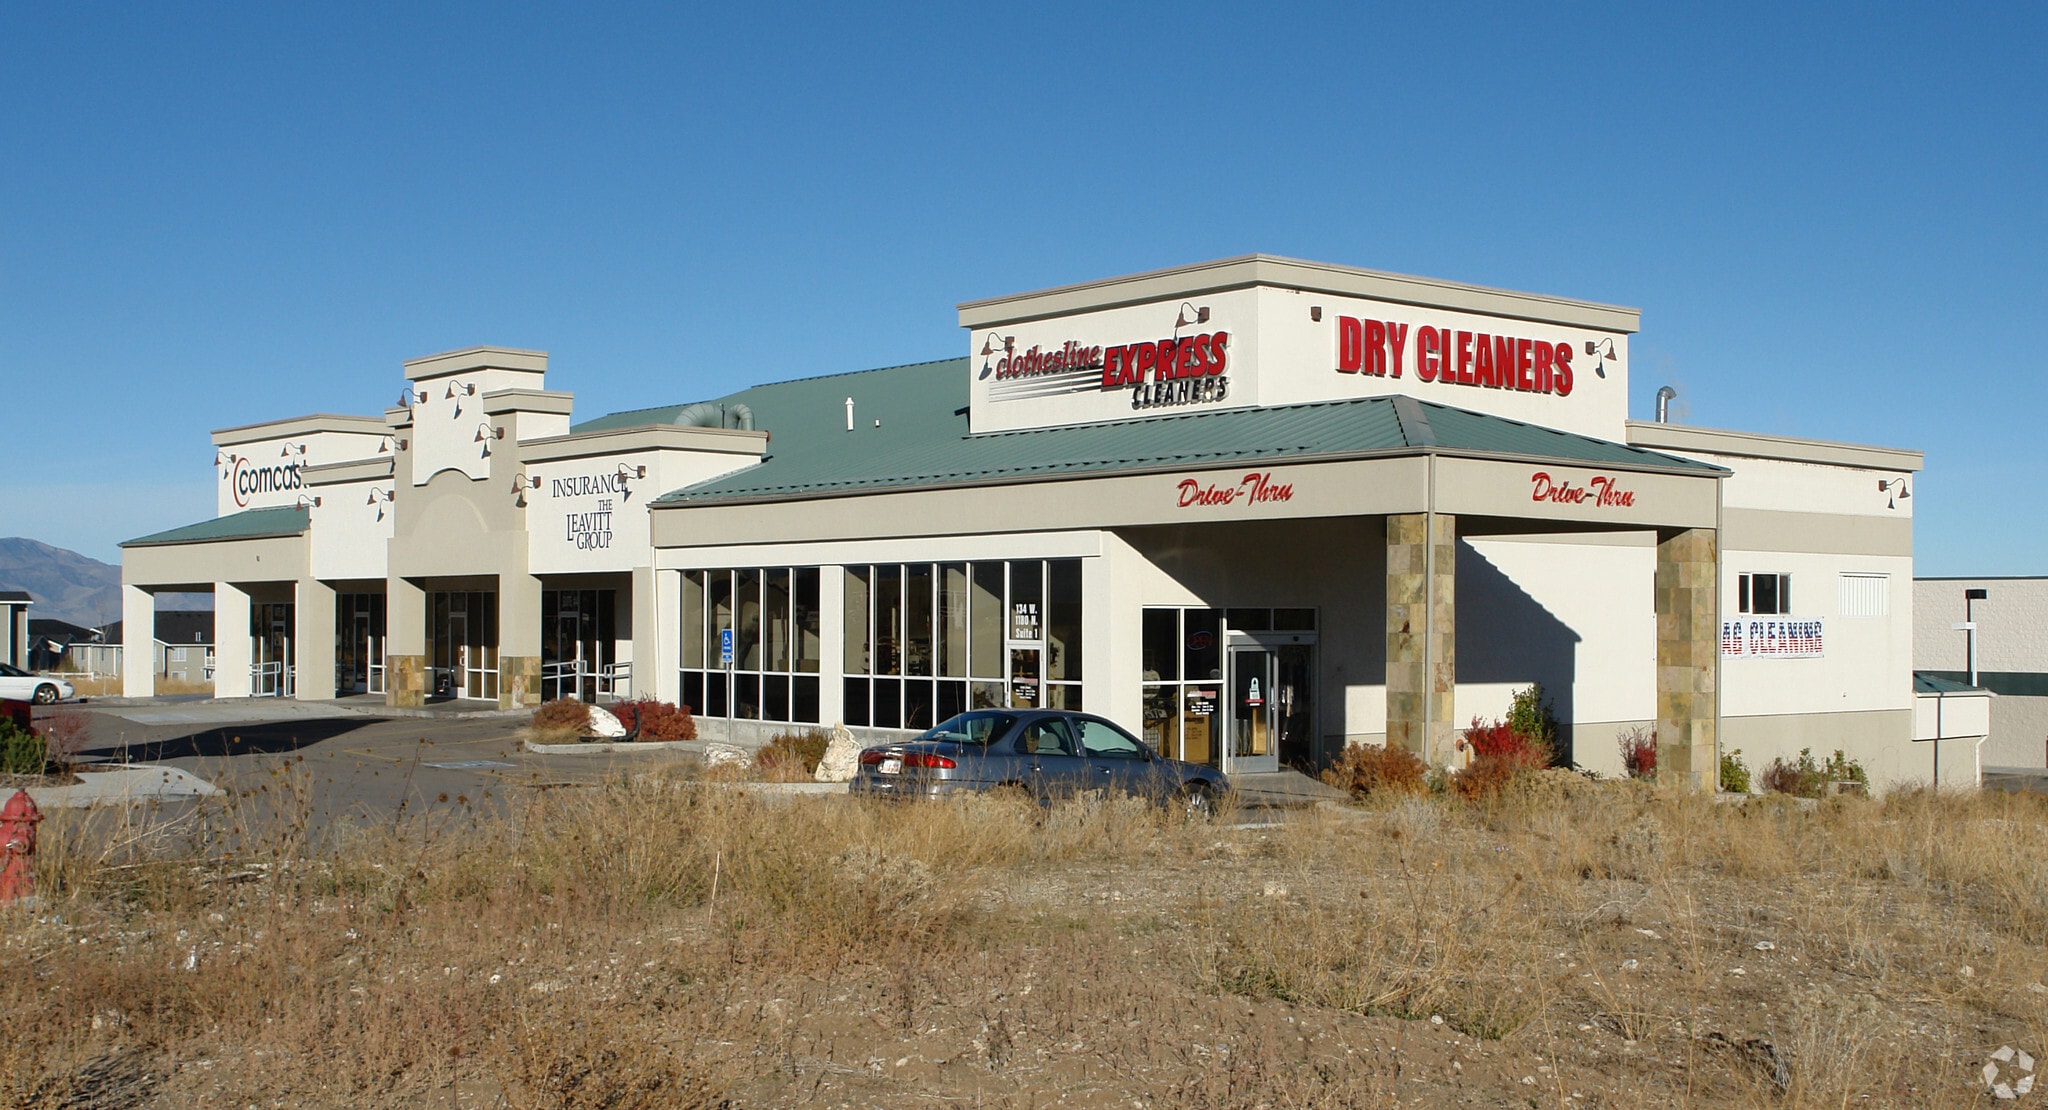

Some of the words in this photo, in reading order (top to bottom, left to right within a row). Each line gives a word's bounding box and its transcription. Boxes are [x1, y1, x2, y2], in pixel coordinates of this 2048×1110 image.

[995, 340, 1102, 381] clothesline
[1101, 331, 1230, 390] EXPRESS
[1335, 315, 1408, 378] DRY
[1415, 325, 1574, 397] CLEANERS
[1132, 376, 1228, 409] CLEANERS
[598, 499, 613, 511] THE
[1176, 472, 1294, 508] Drive-Thru
[1531, 472, 1635, 508] Drive-Thru
[566, 511, 613, 541] LEAVITT
[576, 530, 613, 551] GROUP
[1016, 603, 1027, 614] 134
[1029, 603, 1038, 614] W.
[1015, 628, 1033, 639] Suite
[1034, 628, 1038, 639] 1
[1749, 621, 1822, 654] CLEANING
